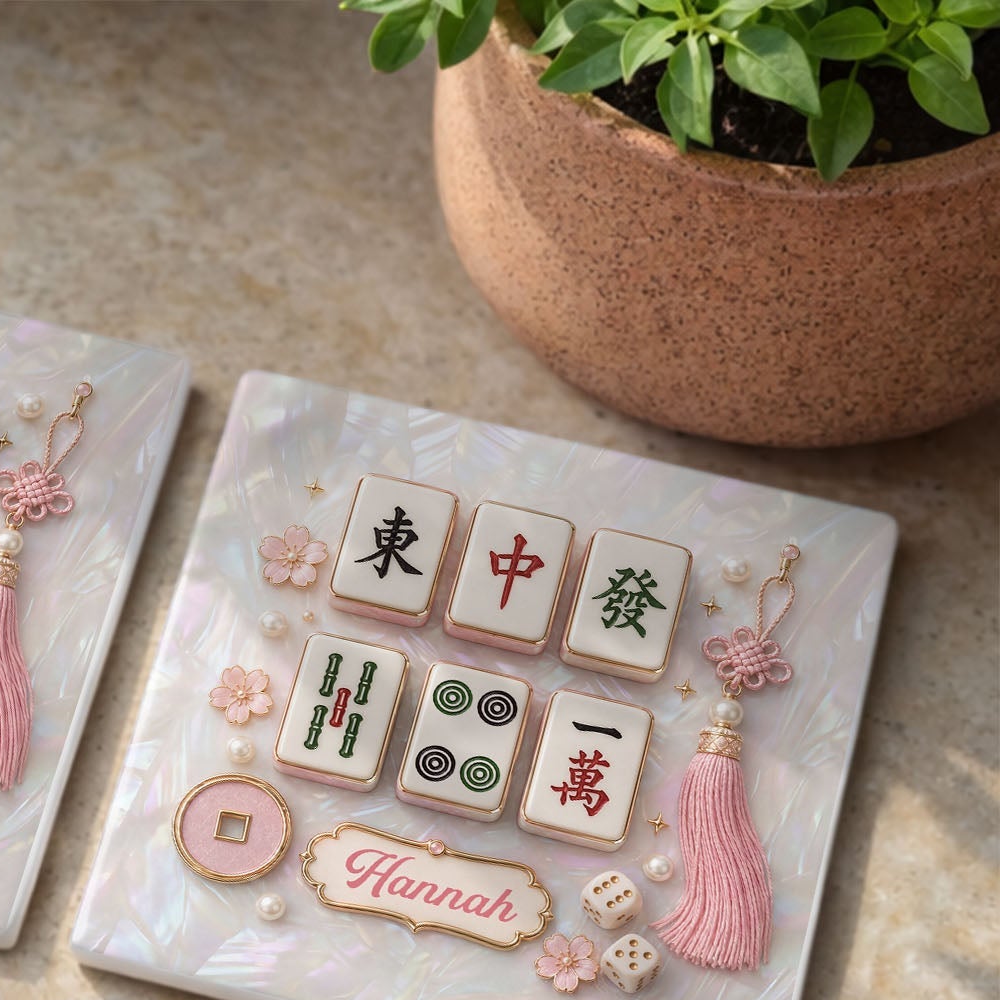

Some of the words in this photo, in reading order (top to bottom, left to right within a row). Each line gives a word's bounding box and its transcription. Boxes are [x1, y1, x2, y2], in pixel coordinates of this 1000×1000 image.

[354, 505, 424, 580] 東
[489, 533, 545, 610] 中
[591, 566, 668, 640] 發
[345, 849, 517, 923] Hannah
